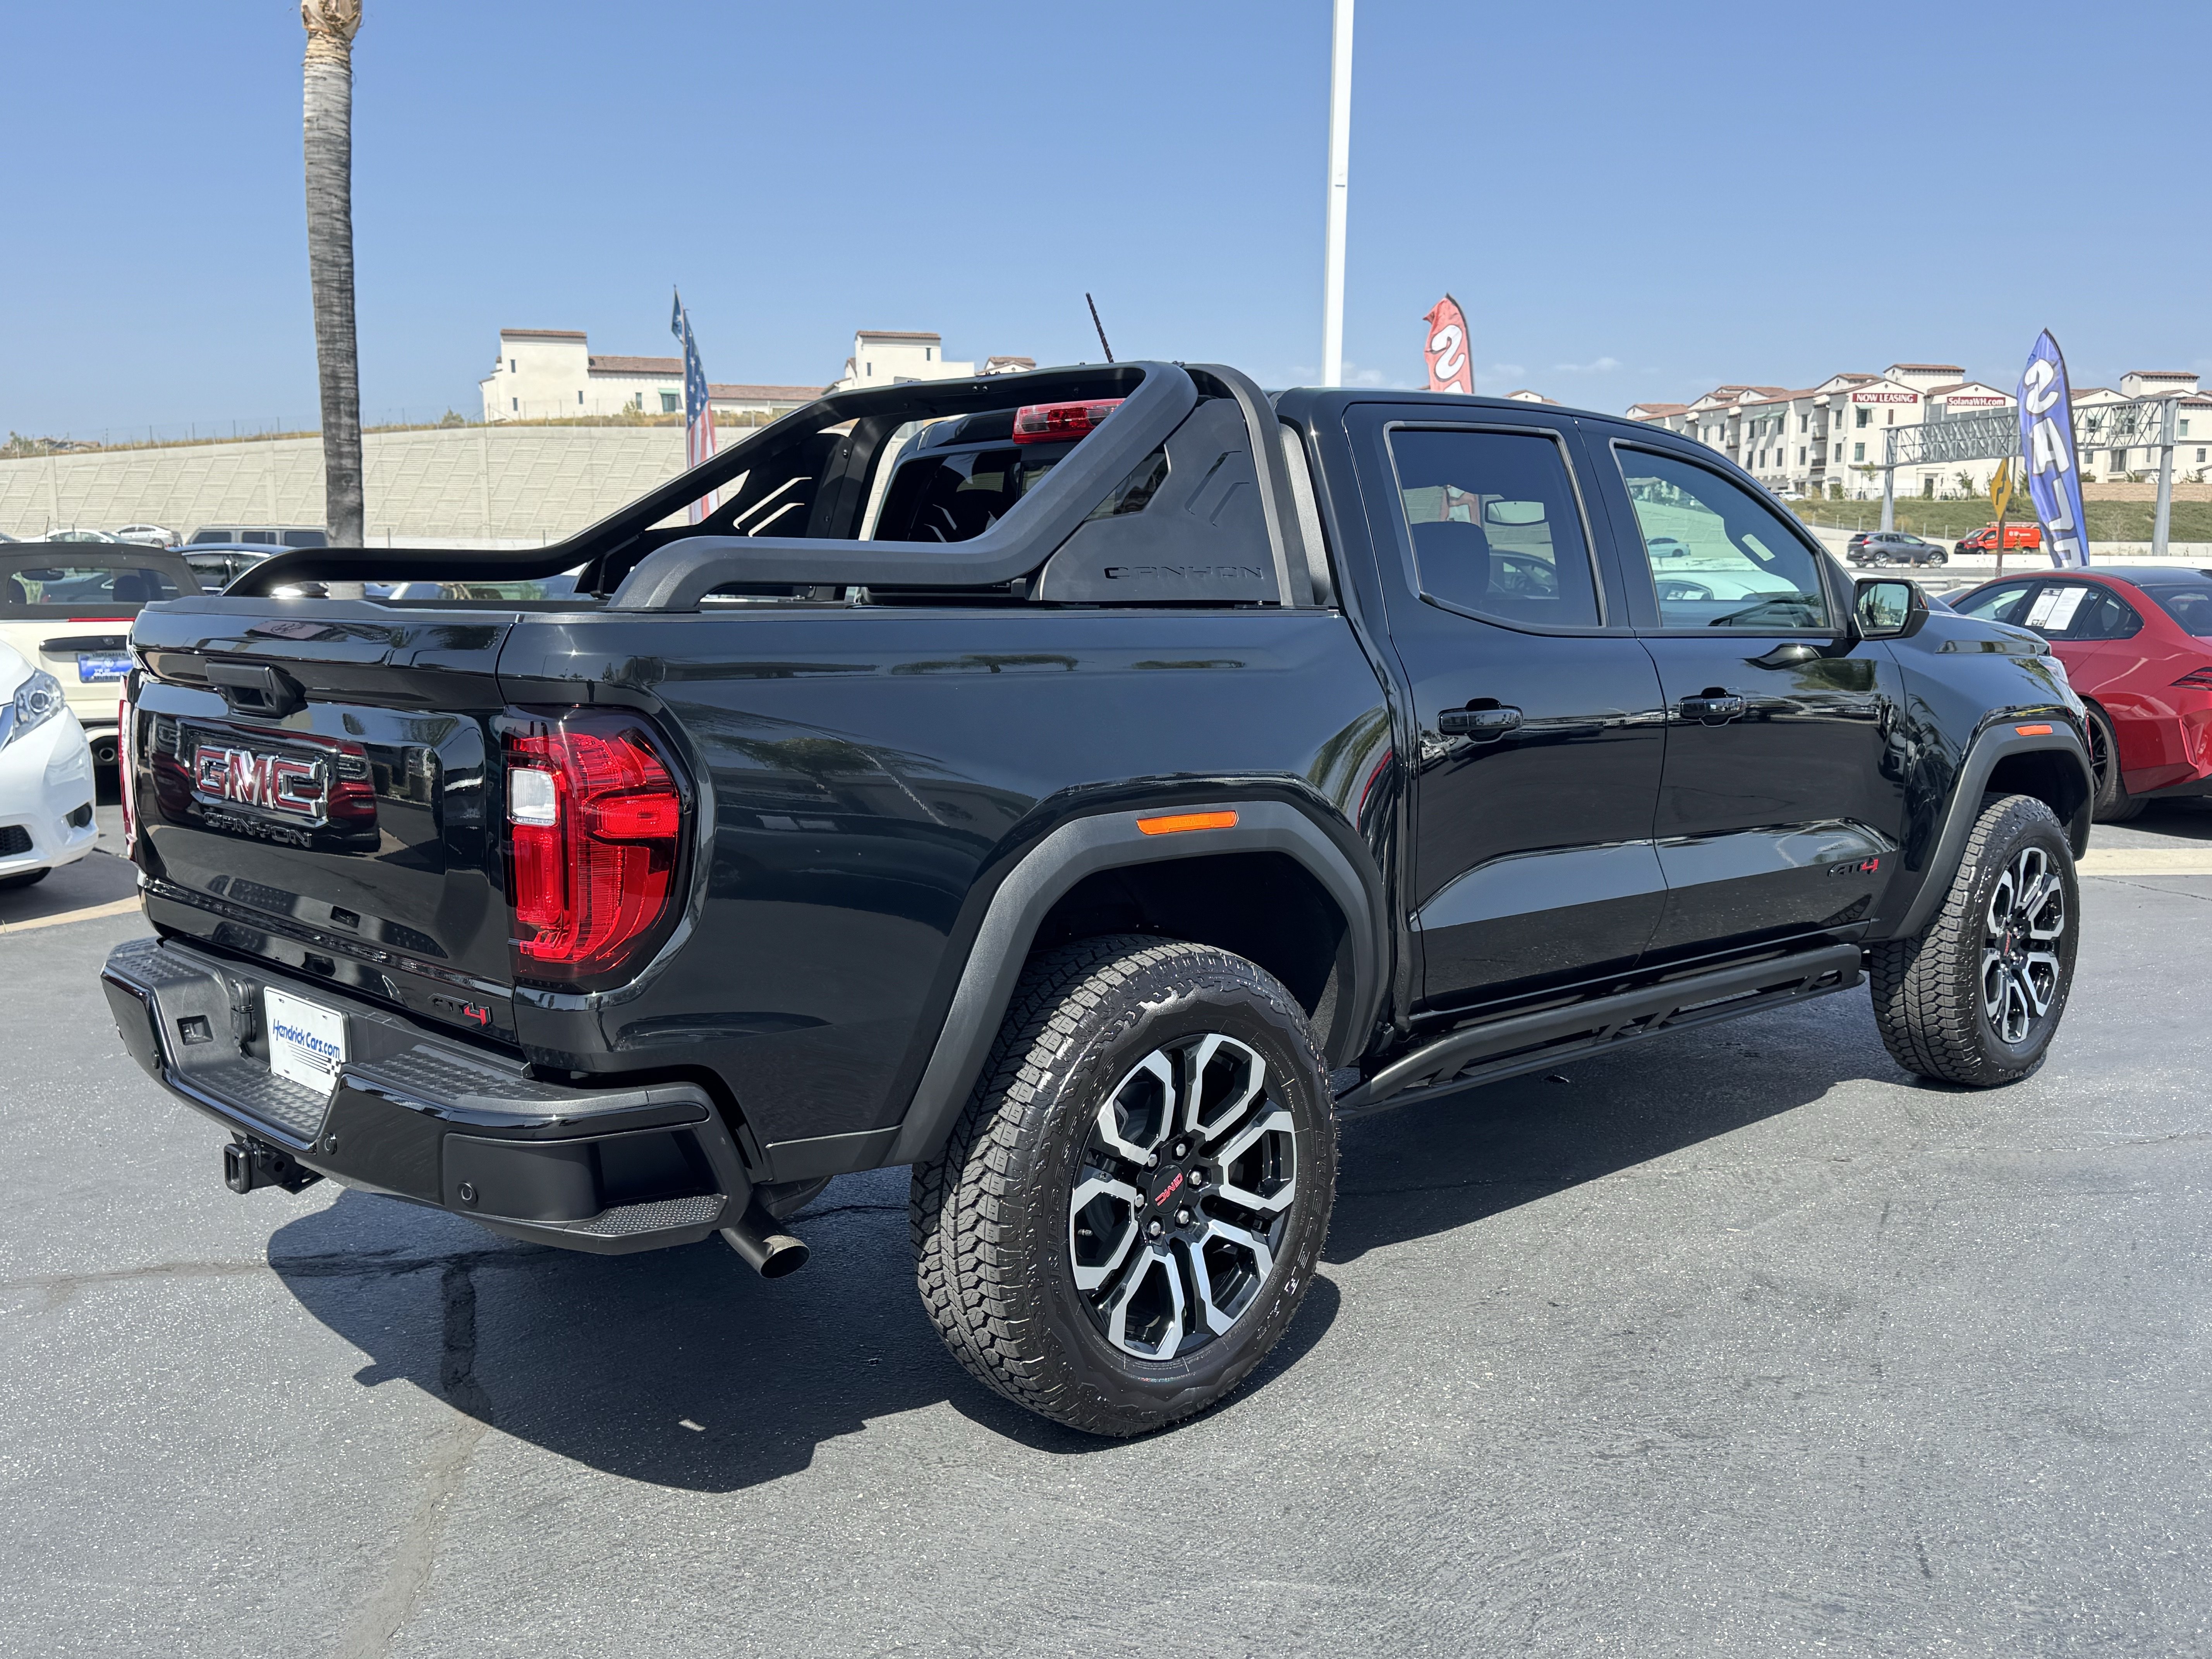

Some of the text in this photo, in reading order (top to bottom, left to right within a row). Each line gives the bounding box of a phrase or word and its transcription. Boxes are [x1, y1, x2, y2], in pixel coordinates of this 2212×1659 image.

[1856, 394, 1913, 402] NOW LEASING
[1948, 397, 2004, 405] SolanaWH.com
[1104, 567, 1264, 579] CANYON
[195, 745, 328, 818] GMC
[204, 812, 313, 848] CANYON
[273, 1018, 341, 1060] Hendrick Cars.com
[1155, 1173, 1183, 1206] GMC
